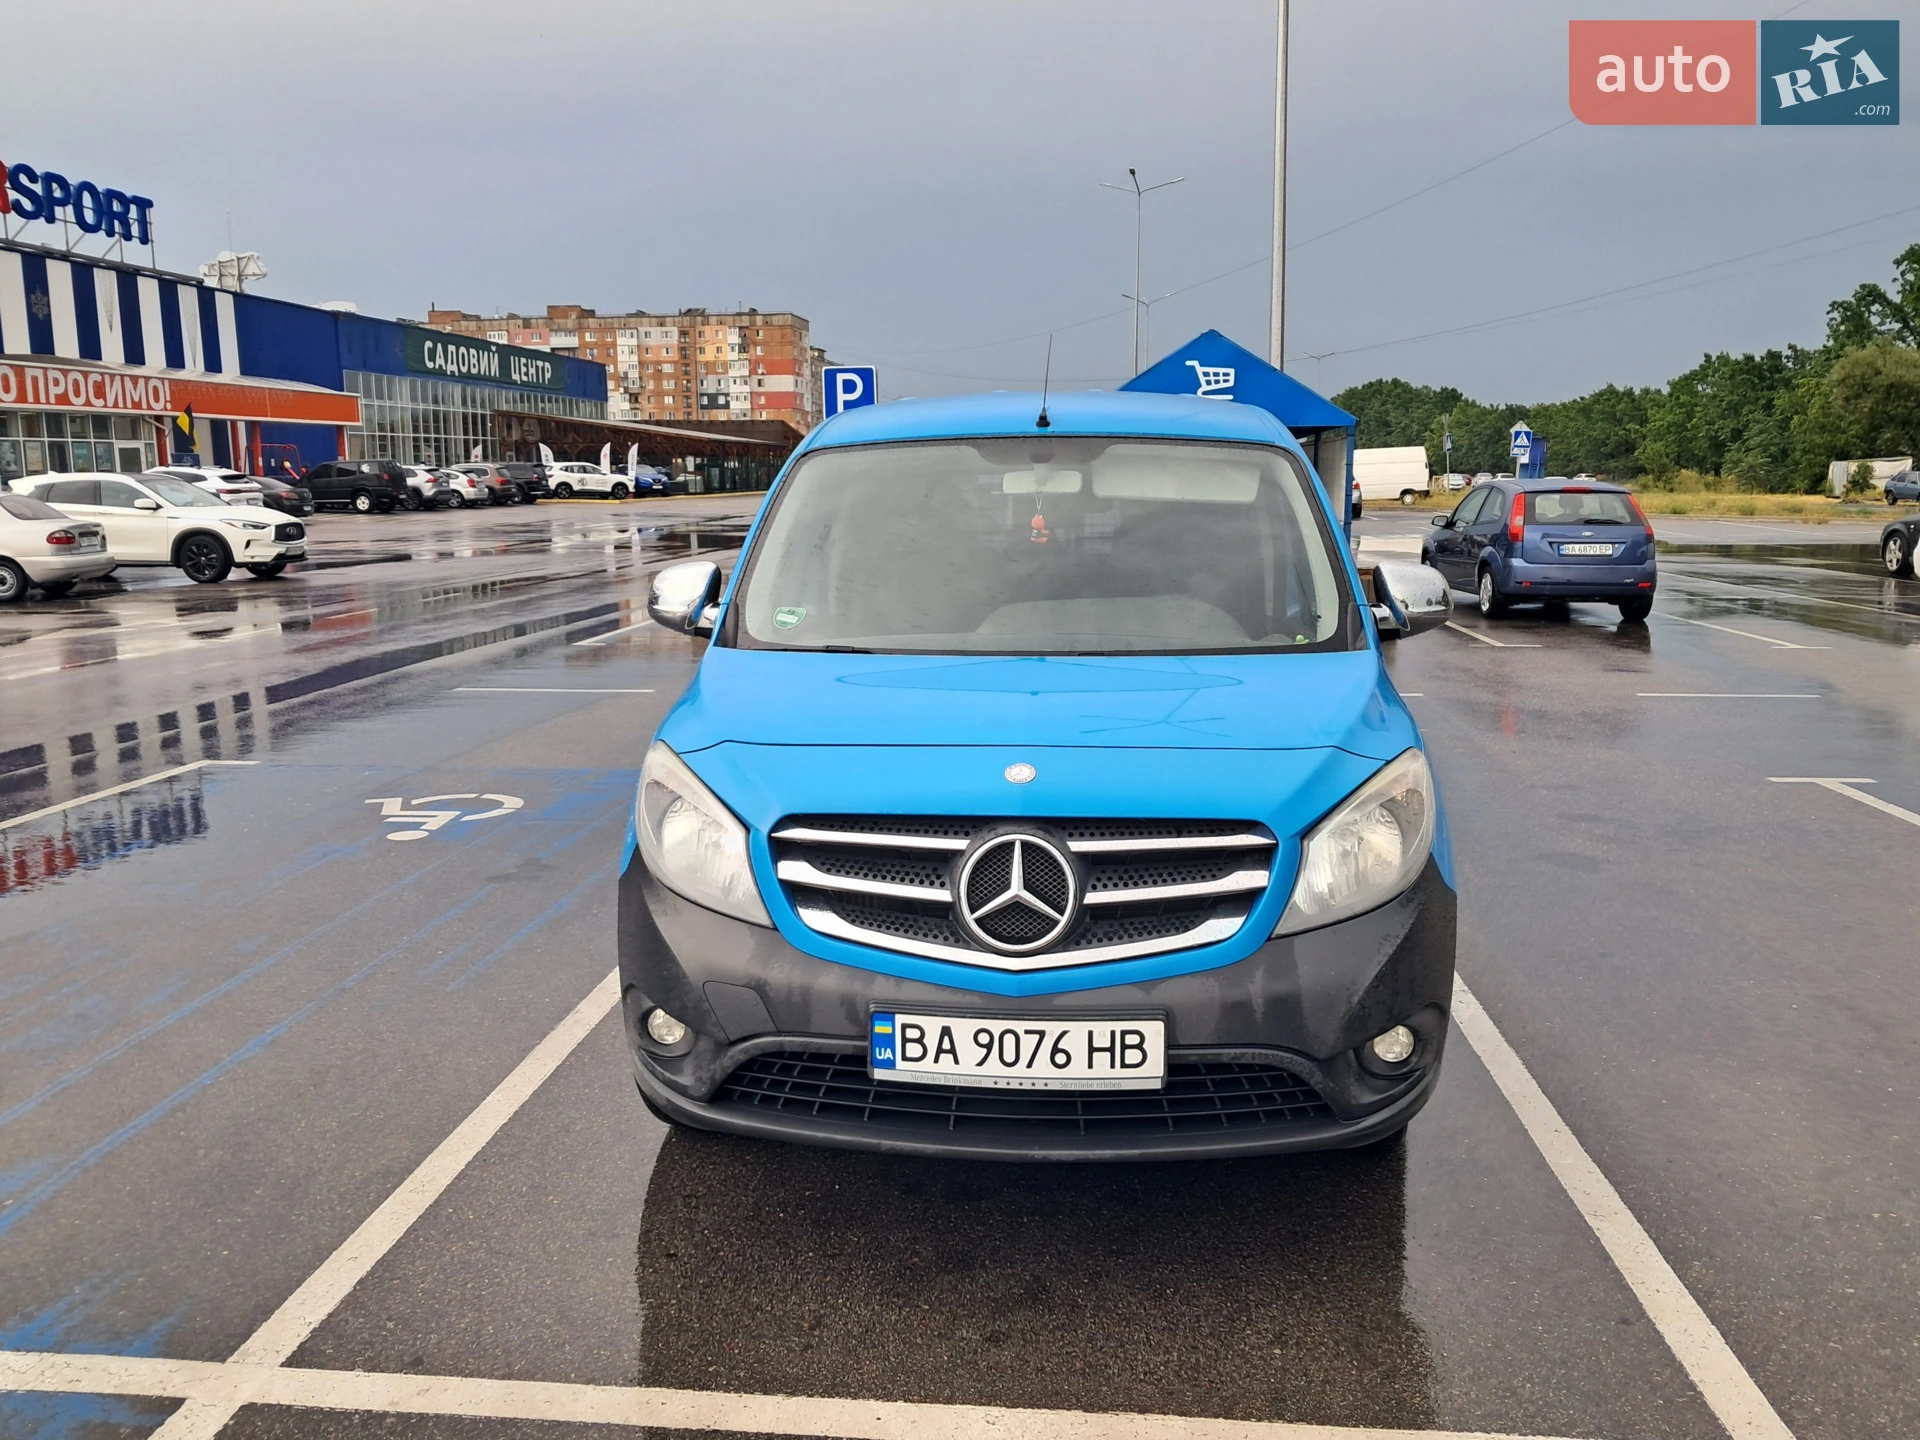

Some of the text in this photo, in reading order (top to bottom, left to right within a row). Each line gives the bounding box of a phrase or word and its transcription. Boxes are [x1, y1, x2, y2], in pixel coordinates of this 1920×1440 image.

[424, 340, 552, 385] САДОВИЙ ЦЕНТР
[25, 367, 172, 411] ПРОСИМО!
[836, 372, 864, 414] P
[1564, 546, 1611, 554] BA 6870 EP
[876, 1047, 893, 1060] UA
[900, 1022, 1148, 1070] BA 9076 HB
[910, 1073, 942, 1083] Mercedes
